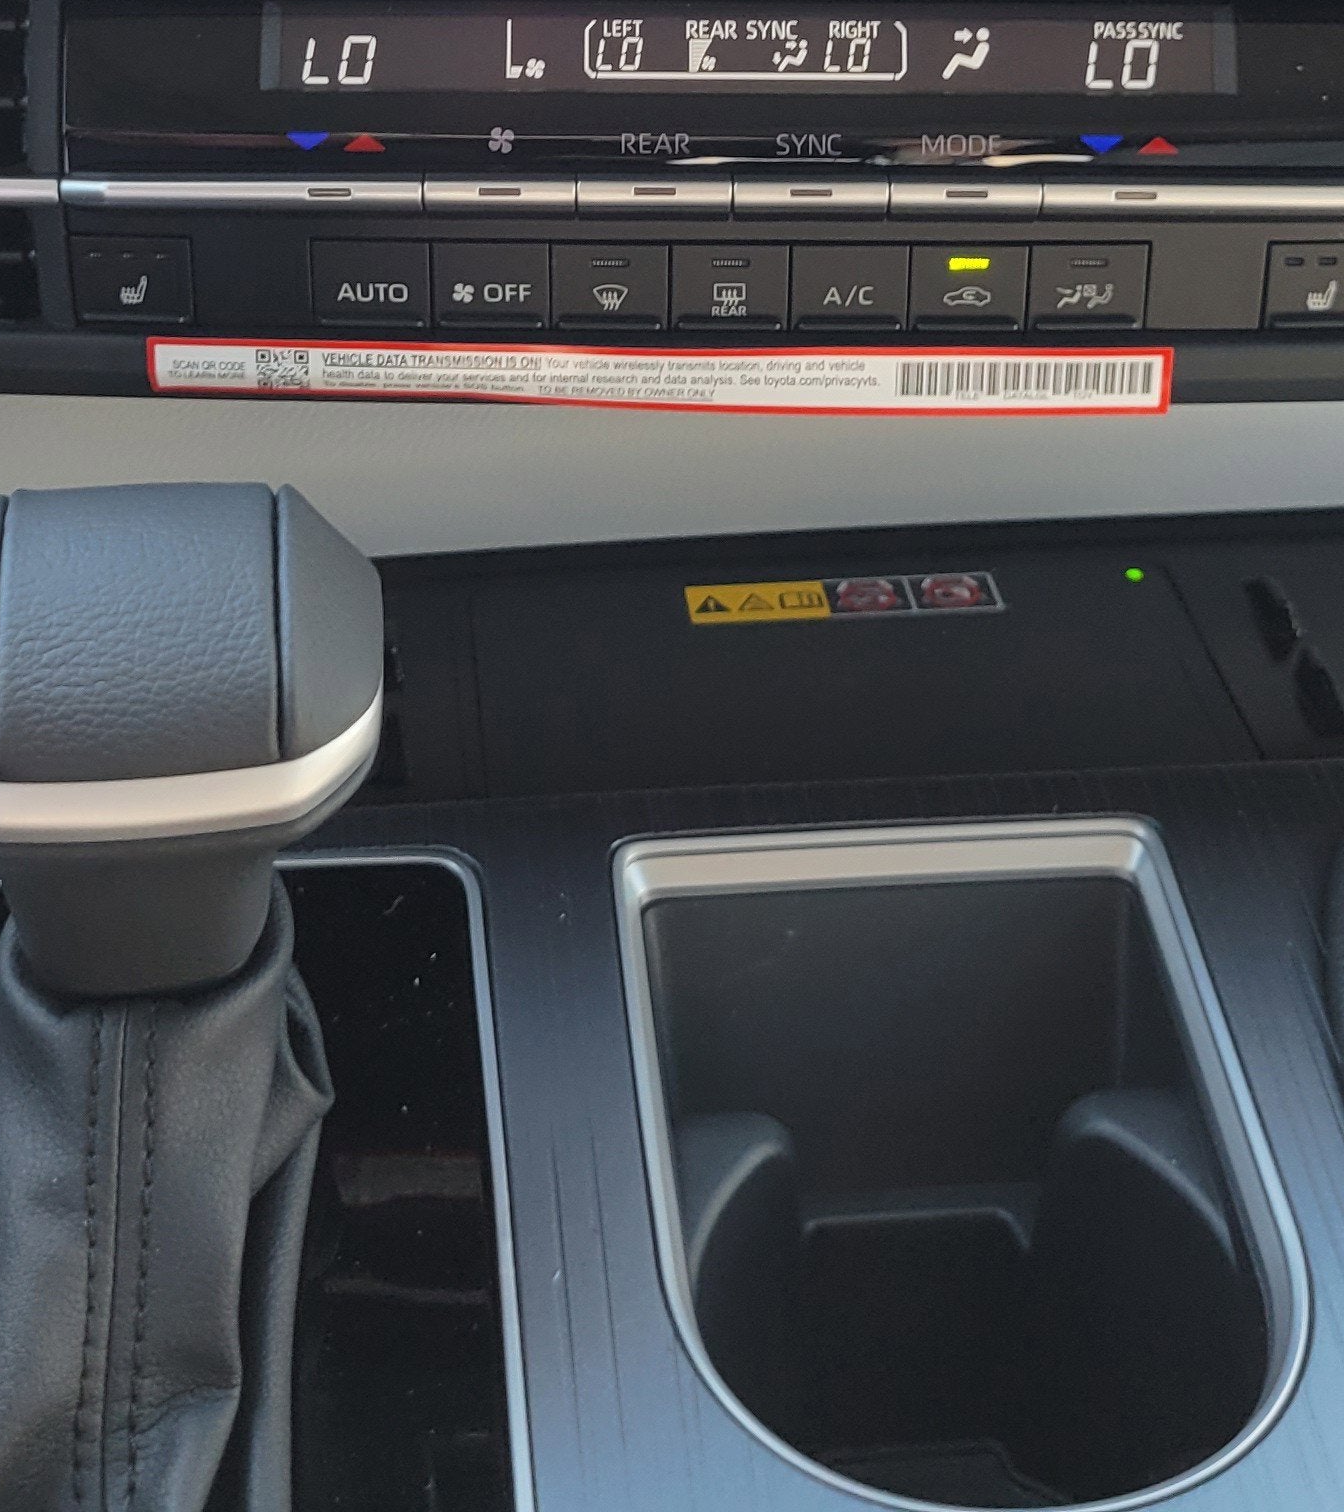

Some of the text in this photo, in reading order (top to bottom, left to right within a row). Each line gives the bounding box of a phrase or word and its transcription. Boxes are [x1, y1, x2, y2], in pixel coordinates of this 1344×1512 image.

[602, 19, 644, 38] LEFT
[685, 20, 799, 41] REAR SYNC
[828, 20, 881, 39] RIGHT
[1093, 22, 1183, 41] PASS SYNC
[621, 132, 691, 155] REAR
[776, 133, 843, 156] SYNC
[921, 134, 1001, 157] MODE
[337, 282, 409, 303] AUTO
[483, 283, 532, 304] OFF
[822, 285, 875, 307] A/C
[711, 305, 747, 317] REAR
[172, 359, 199, 370] SCAN
[219, 361, 246, 371] CODE
[321, 353, 373, 366] VEHICLE
[376, 354, 408, 367] DATA
[410, 355, 502, 368] TRANSMISSION
[546, 357, 570, 370] Your
[614, 360, 665, 375] wirelessly
[766, 360, 802, 373] driving
[804, 360, 825, 372] and
[829, 360, 866, 372] vehicle
[322, 368, 355, 380] health
[357, 369, 381, 380] data
[509, 373, 529, 383] and
[532, 372, 547, 383] for
[550, 373, 589, 384] internal
[592, 374, 638, 384] research
[641, 374, 661, 385] and
[664, 374, 687, 385] data
[739, 374, 761, 386] See
